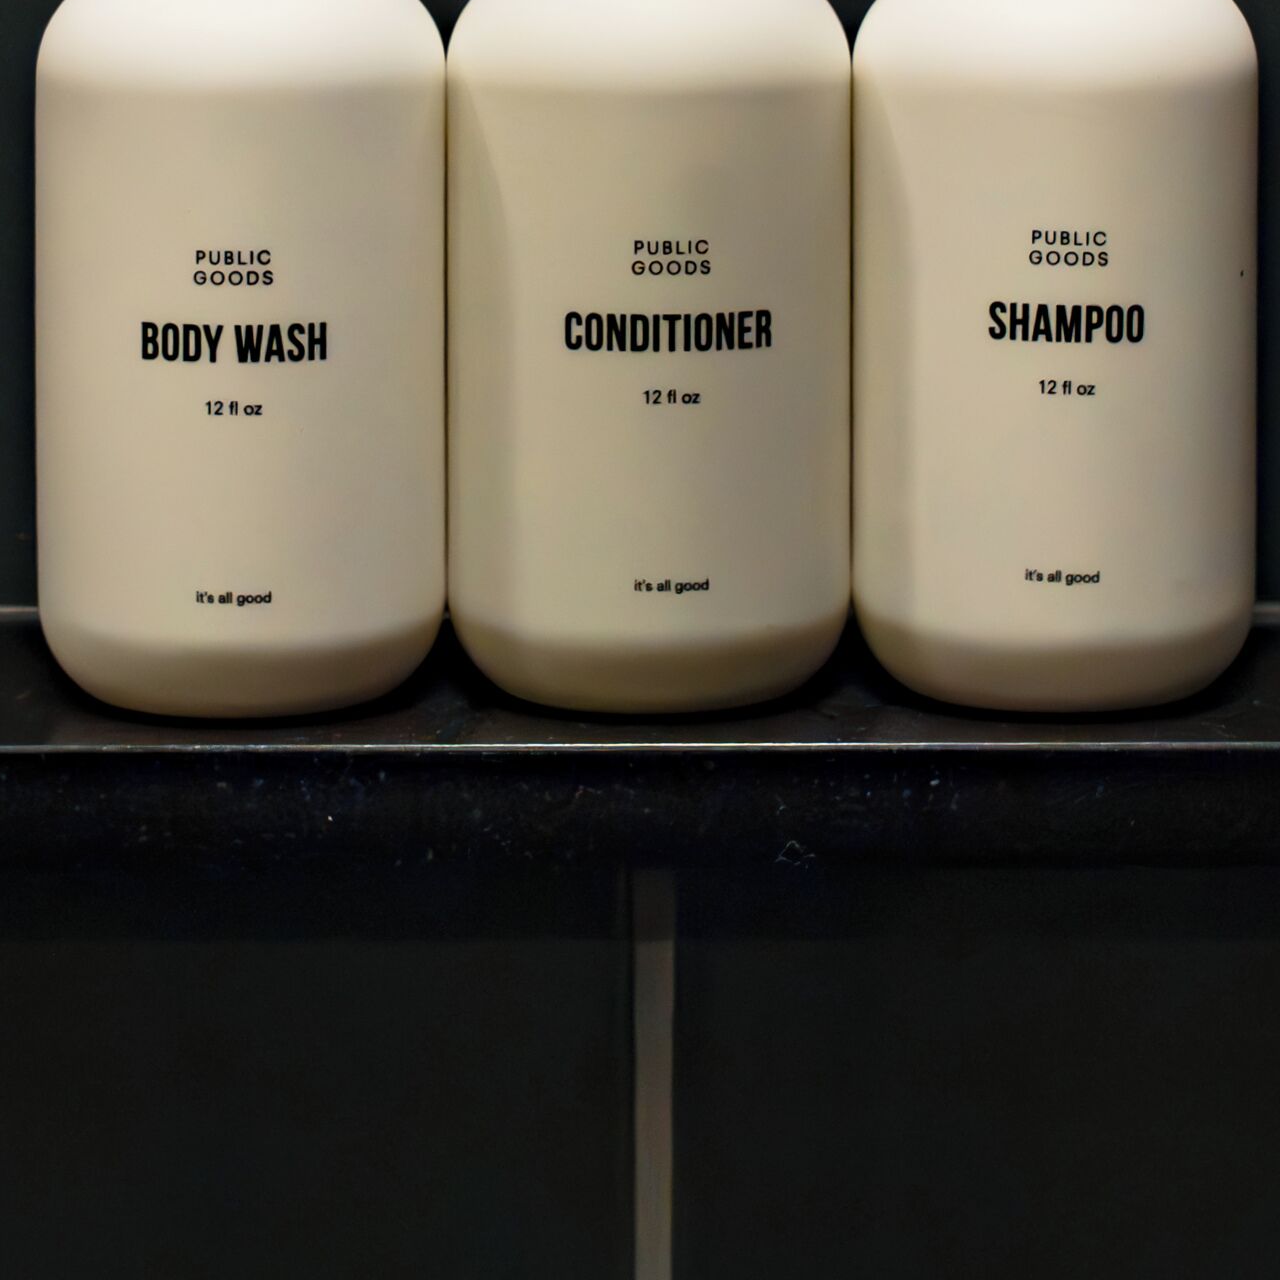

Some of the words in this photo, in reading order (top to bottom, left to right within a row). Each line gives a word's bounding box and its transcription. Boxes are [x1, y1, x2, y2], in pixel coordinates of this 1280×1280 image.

[1032, 230, 1107, 246] PUBLIC
[634, 240, 709, 255] PUBLIC
[196, 249, 271, 266] PUBLIC
[1029, 250, 1108, 267] GOODS
[631, 260, 711, 275] GOODS
[193, 270, 273, 286] GOODS
[564, 309, 772, 352] CONDITIONER
[988, 301, 1144, 344] SHAMPOO
[141, 321, 224, 363] BODY
[234, 322, 327, 364] WASH
[1039, 380, 1057, 395] 12
[1062, 380, 1072, 395] fl
[1076, 384, 1096, 396] oz
[643, 390, 662, 405] 12
[667, 389, 677, 404] fl
[681, 393, 700, 404] oz
[205, 400, 224, 416] 12
[228, 401, 238, 416] fl
[243, 404, 262, 416] oz
[1025, 569, 1044, 582] it's
[1047, 570, 1062, 583] all
[1065, 571, 1100, 586] good
[634, 579, 653, 592] it's
[656, 579, 671, 592] all
[674, 578, 709, 594] good
[196, 591, 215, 604] it's
[218, 592, 233, 604] all
[236, 591, 272, 607] good
